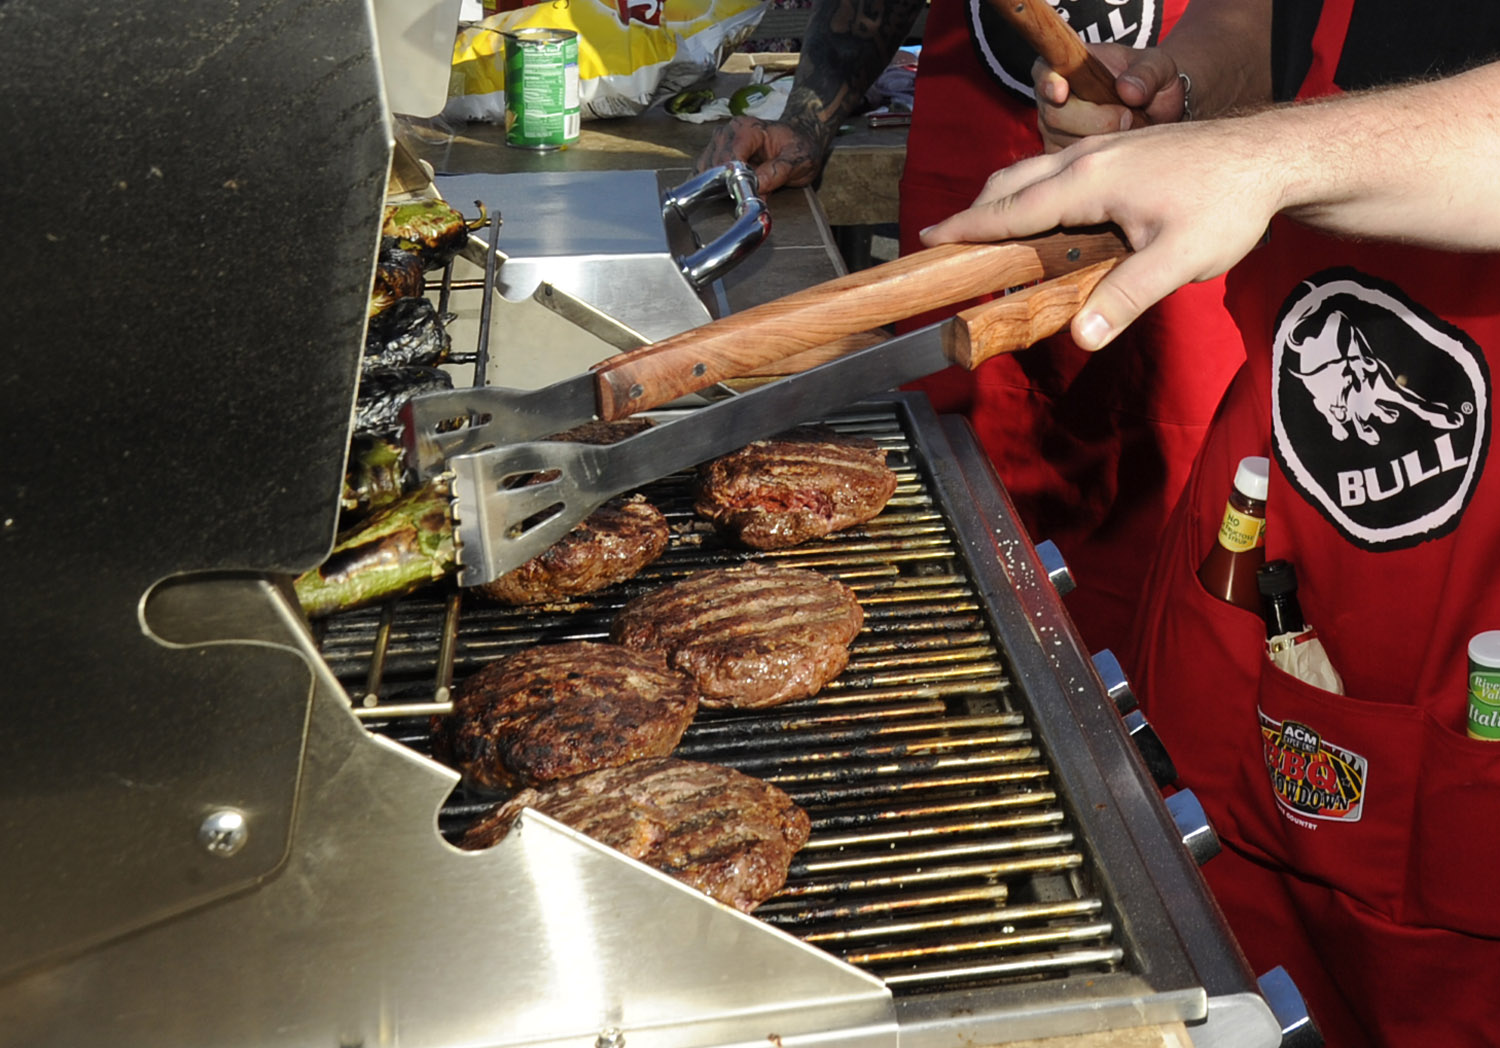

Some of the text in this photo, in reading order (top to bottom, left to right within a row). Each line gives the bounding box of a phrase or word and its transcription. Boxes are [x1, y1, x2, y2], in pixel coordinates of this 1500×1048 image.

[1337, 432, 1468, 507] BULL
[1227, 513, 1240, 527] NO
[1285, 726, 1317, 745] ACM
[1264, 740, 1338, 793] BBQ
[1270, 768, 1350, 810] OWDOWN
